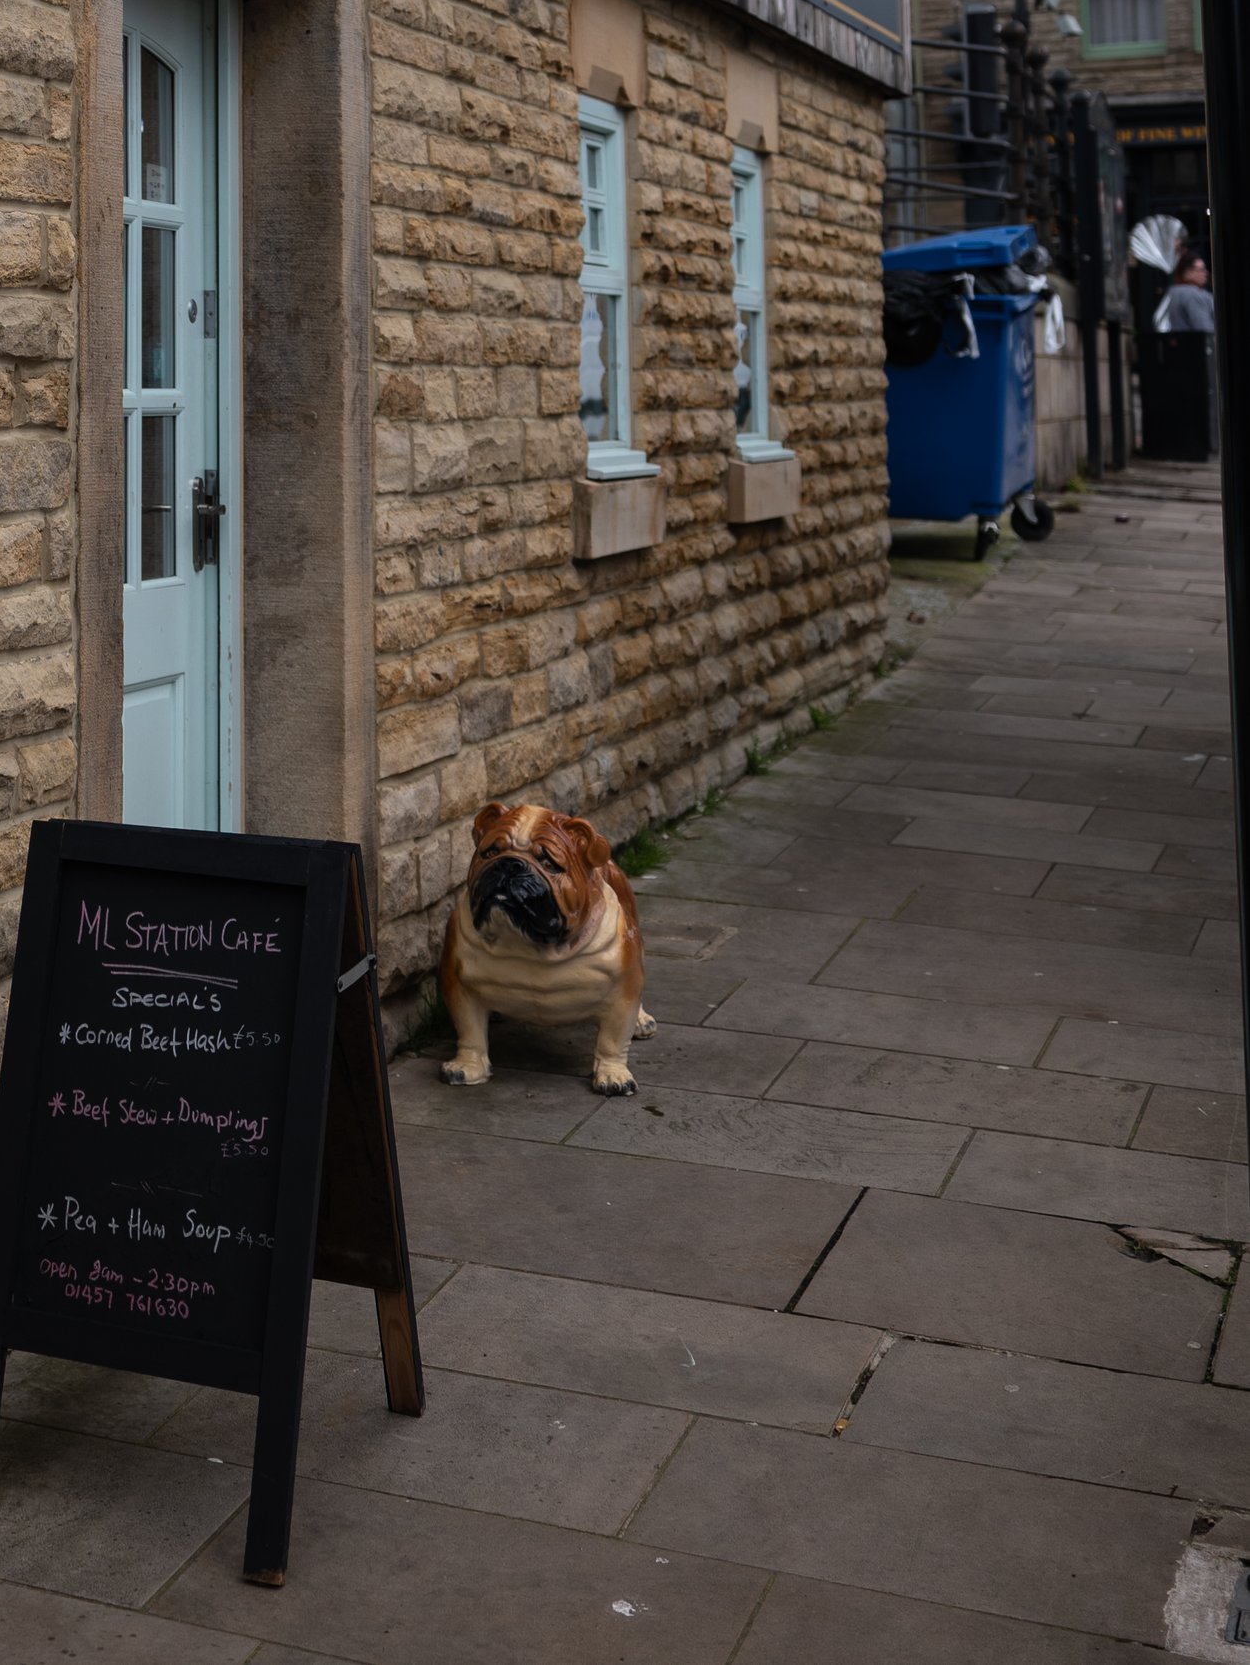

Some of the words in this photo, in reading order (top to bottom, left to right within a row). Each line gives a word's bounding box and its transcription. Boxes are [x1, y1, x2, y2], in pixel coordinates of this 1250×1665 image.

[77, 899, 116, 951] ML
[124, 911, 213, 956] STATION
[75, 1023, 133, 1053] Corned
[140, 1023, 183, 1058] Beef
[186, 1027, 231, 1053] Hash
[233, 1025, 281, 1050] £5.50
[72, 1090, 110, 1127] Beef
[119, 1099, 157, 1125] Stew
[178, 1097, 269, 1142] Dumplings
[221, 1142, 269, 1158] £5.50
[64, 1195, 97, 1234] Pea
[128, 1207, 166, 1241] Ham
[182, 1208, 231, 1254] Soup
[64, 1283, 113, 1309] 01457
[125, 1293, 190, 1319] 761630
[147, 1269, 215, 1298] 2.30pm
